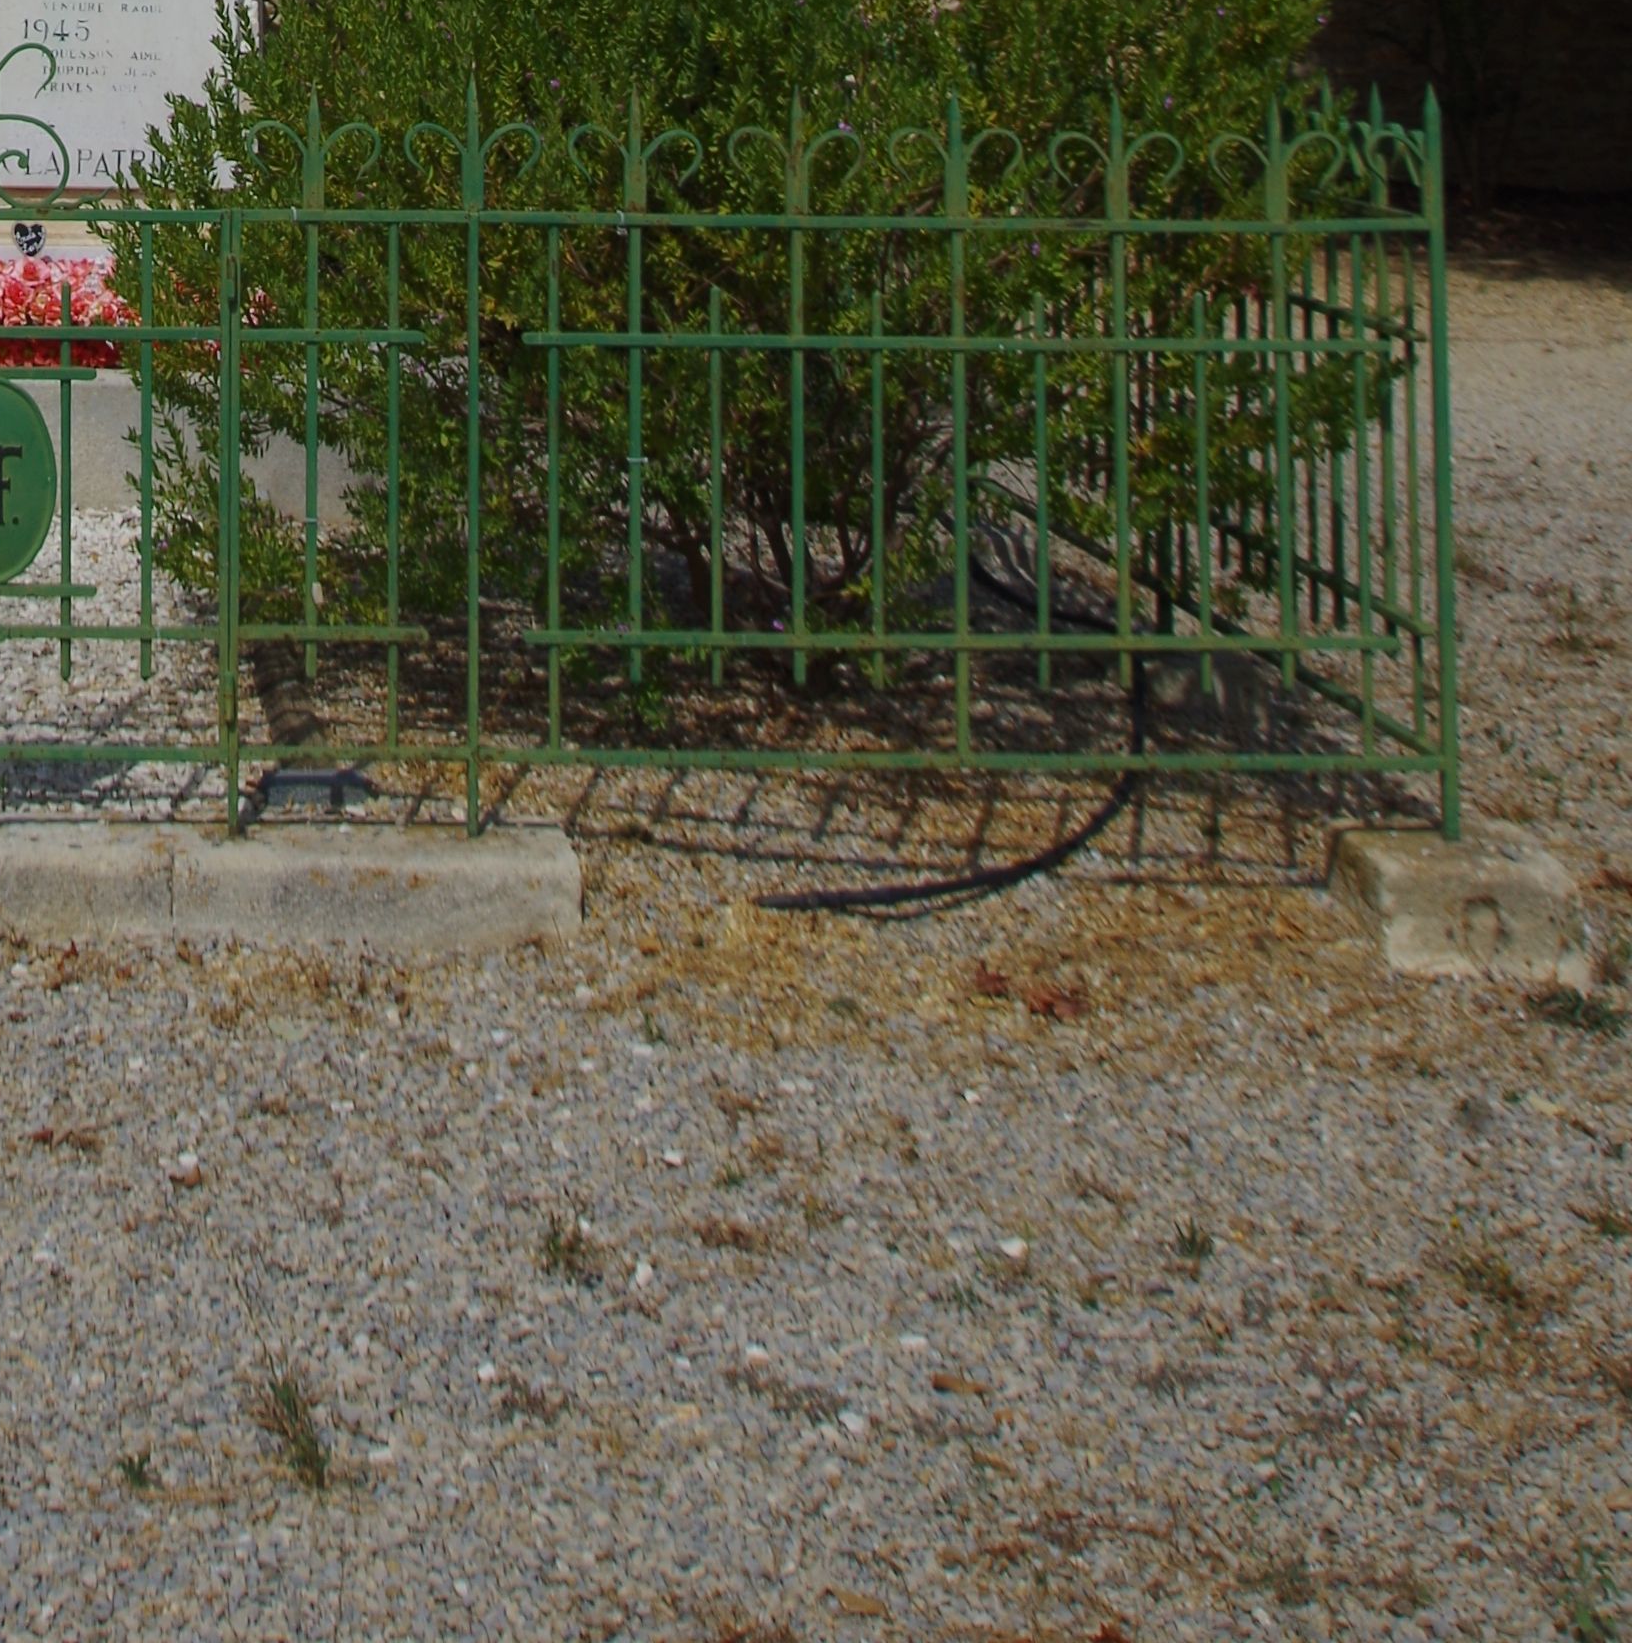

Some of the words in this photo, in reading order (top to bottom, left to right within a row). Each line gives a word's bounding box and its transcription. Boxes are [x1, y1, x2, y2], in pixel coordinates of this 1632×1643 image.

[121, 3, 163, 13] RAOUL
[23, 18, 90, 43] 1945
[43, 83, 93, 92] RIVES
[24, 148, 61, 175] LA
